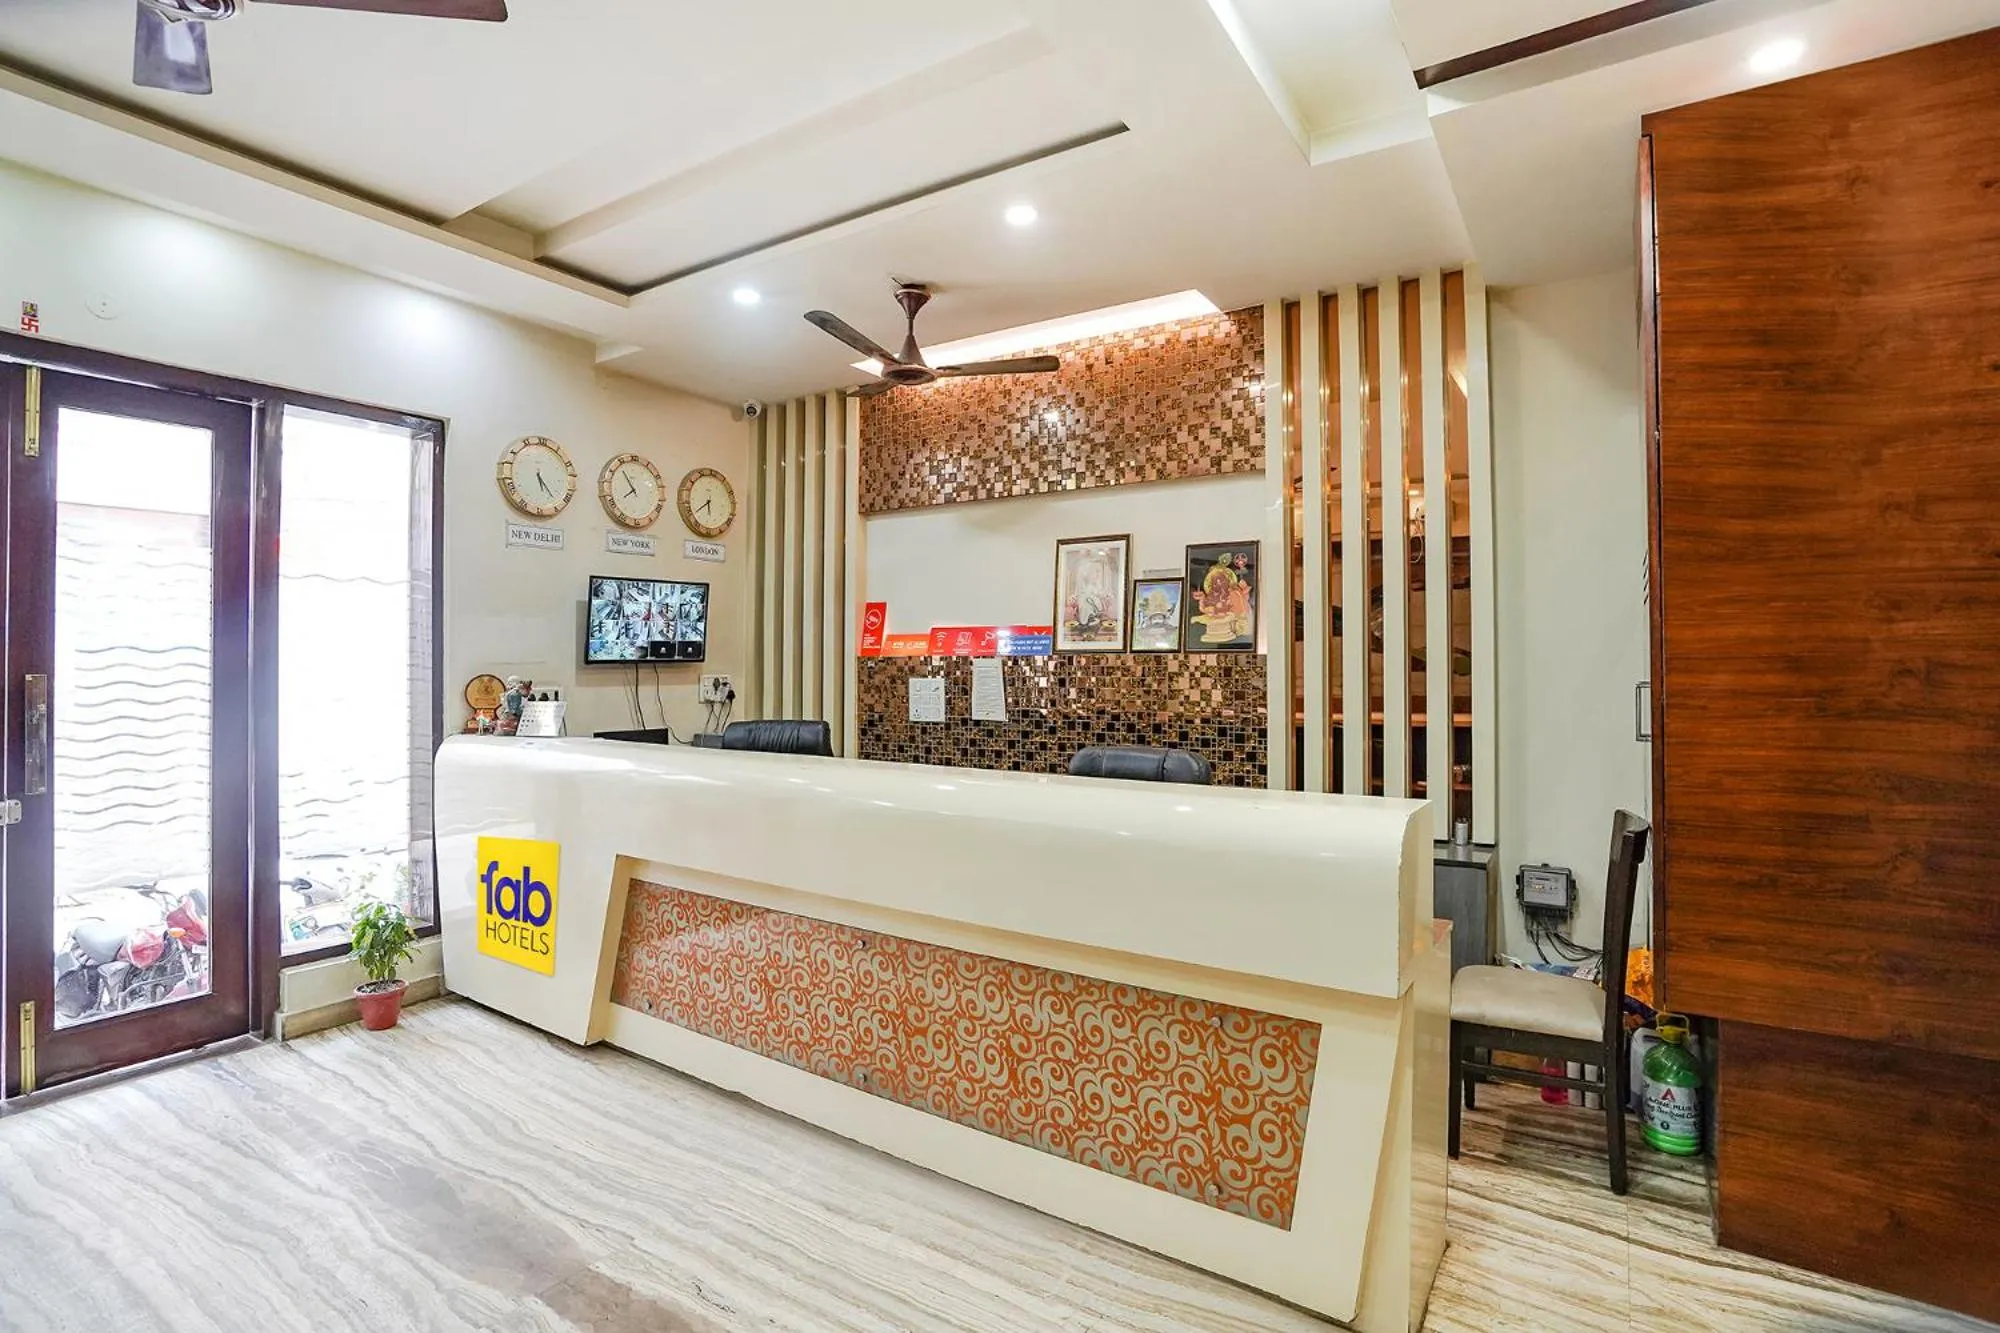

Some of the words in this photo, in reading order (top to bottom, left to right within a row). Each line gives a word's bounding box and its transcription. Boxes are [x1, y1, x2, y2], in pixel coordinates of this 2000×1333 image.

[511, 528, 532, 540] NEW
[534, 532, 561, 543] DELHI
[611, 537, 628, 546] NEW
[630, 539, 650, 549] YORK
[691, 545, 719, 556] LONDON
[480, 860, 552, 928] fab
[485, 918, 550, 955] HOTELS
